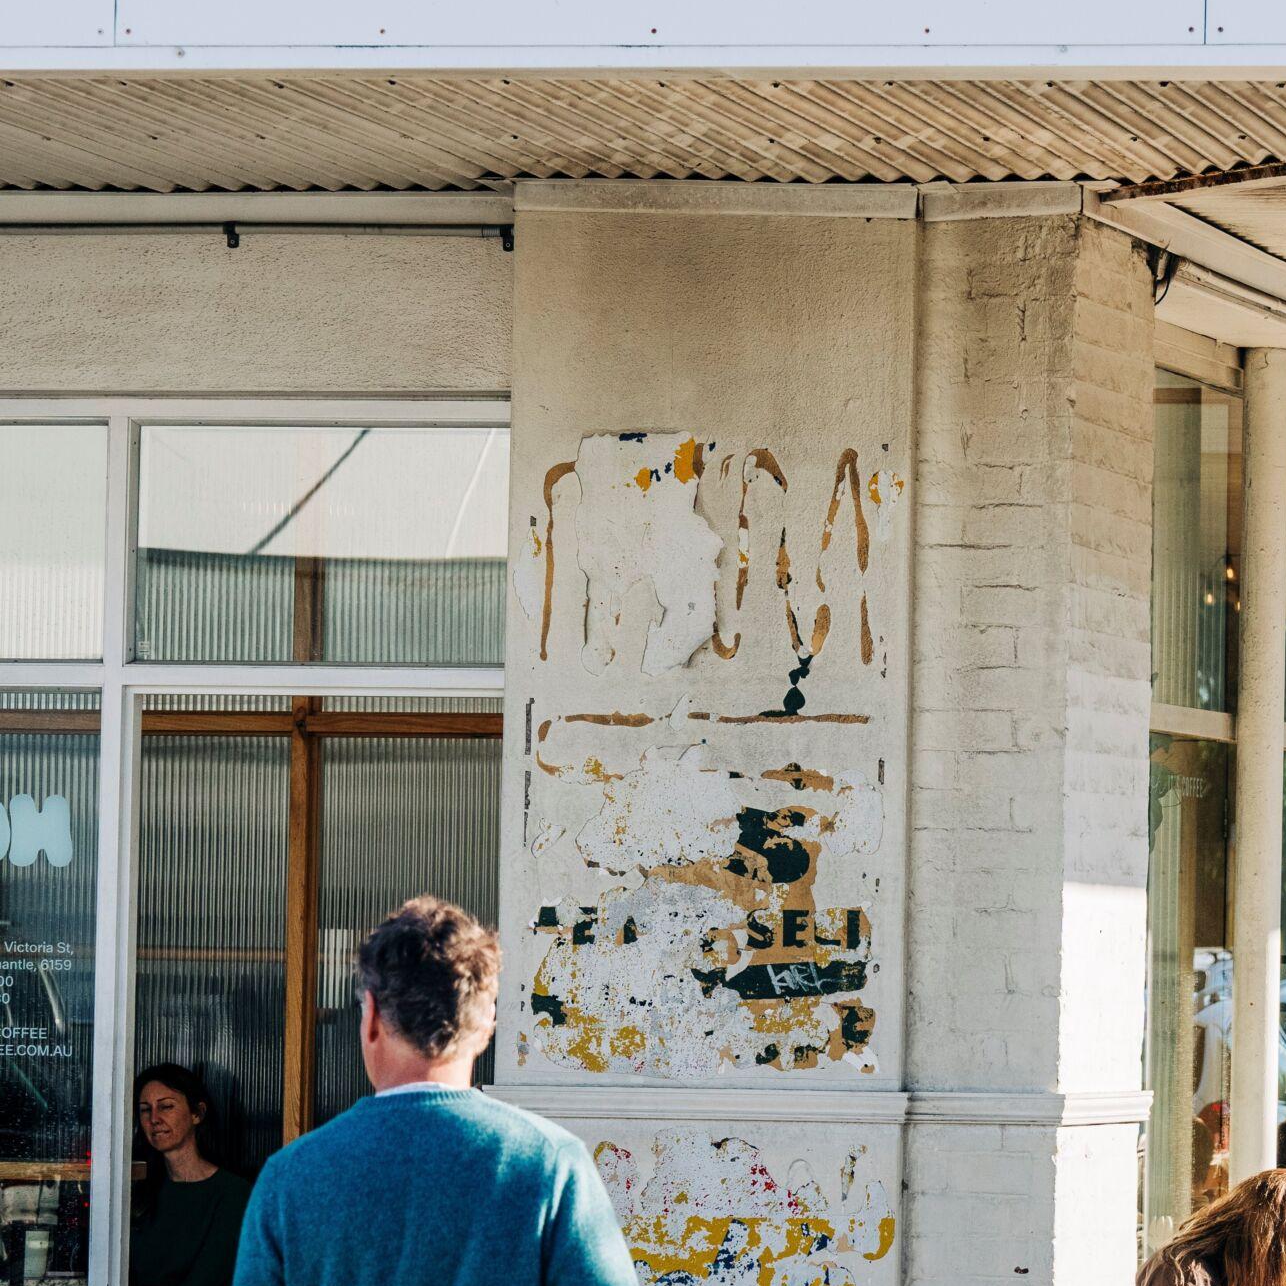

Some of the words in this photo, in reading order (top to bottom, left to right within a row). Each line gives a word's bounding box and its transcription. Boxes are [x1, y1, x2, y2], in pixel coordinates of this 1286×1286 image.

[4, 941, 53, 954] Victoria
[56, 942, 74, 955] St,
[0, 959, 37, 972] antle,
[40, 959, 72, 971] 6159
[0, 1027, 47, 1039] OFFEE
